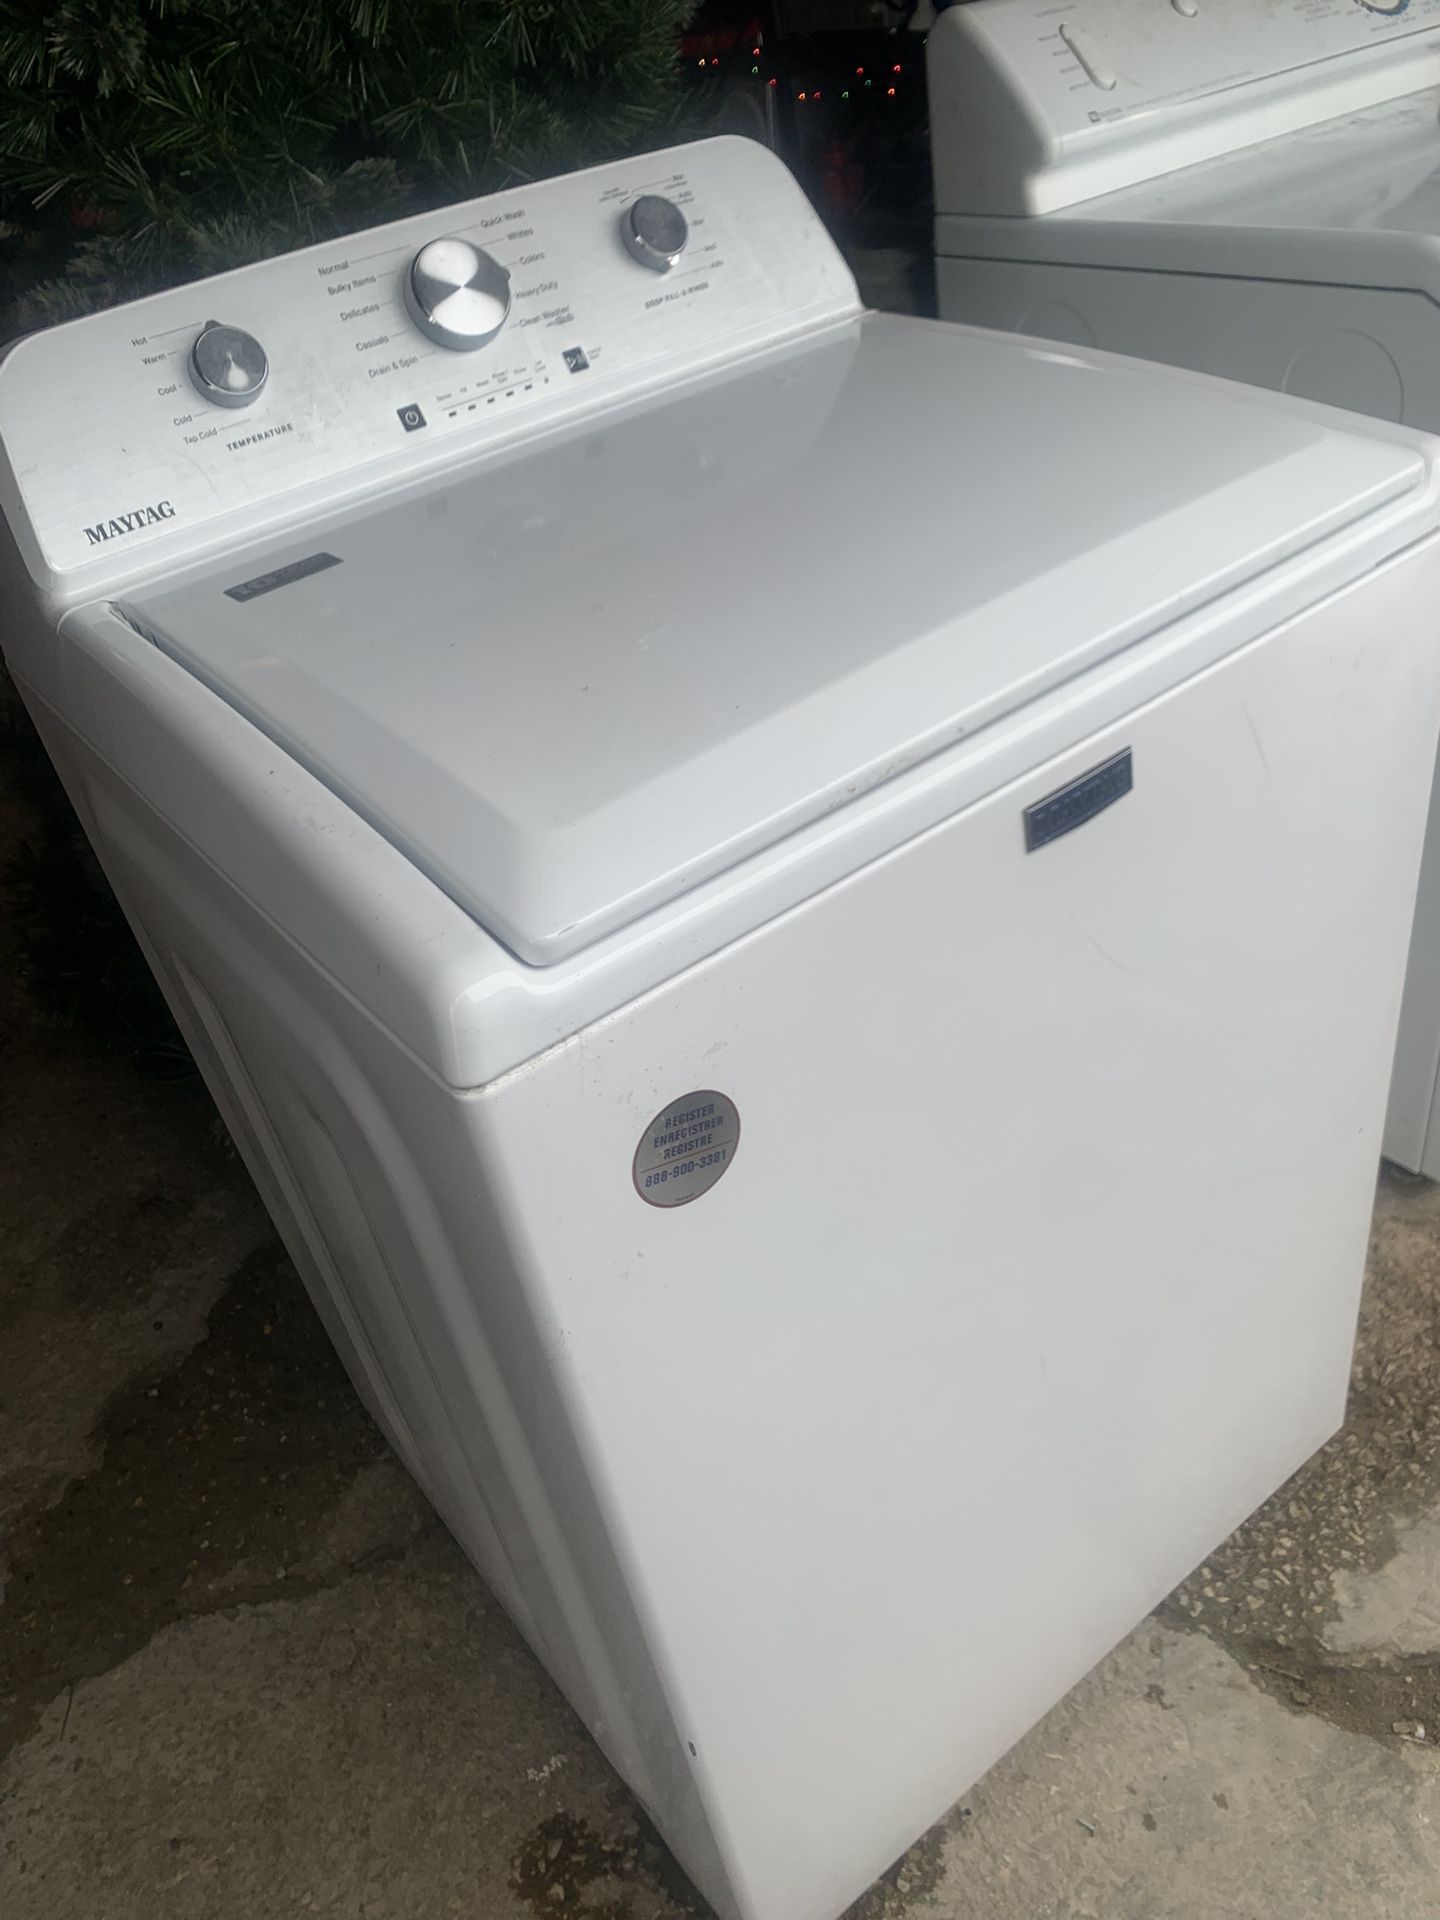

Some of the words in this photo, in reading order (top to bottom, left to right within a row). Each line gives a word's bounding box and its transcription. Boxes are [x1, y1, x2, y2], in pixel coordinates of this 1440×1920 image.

[519, 251, 545, 266] Colors
[318, 260, 350, 276] Normal
[327, 283, 352, 296] Bulky
[340, 303, 380, 321] Delicates
[131, 336, 148, 347] Hot
[141, 353, 166, 366] Warm
[368, 364, 391, 379] Drain
[399, 356, 418, 369] Spin
[157, 386, 177, 397] Cool
[173, 414, 193, 427] Cold
[183, 436, 199, 446] Tap
[198, 428, 218, 440] Cold
[226, 423, 294, 452] TEMPERATURE
[83, 500, 176, 545] MAYTAG
[664, 1104, 715, 1130] REGISTER
[654, 1116, 724, 1148] ENREGISTRER
[663, 1134, 713, 1160] REGISTRE
[645, 1149, 727, 1188] 888-900-3381
